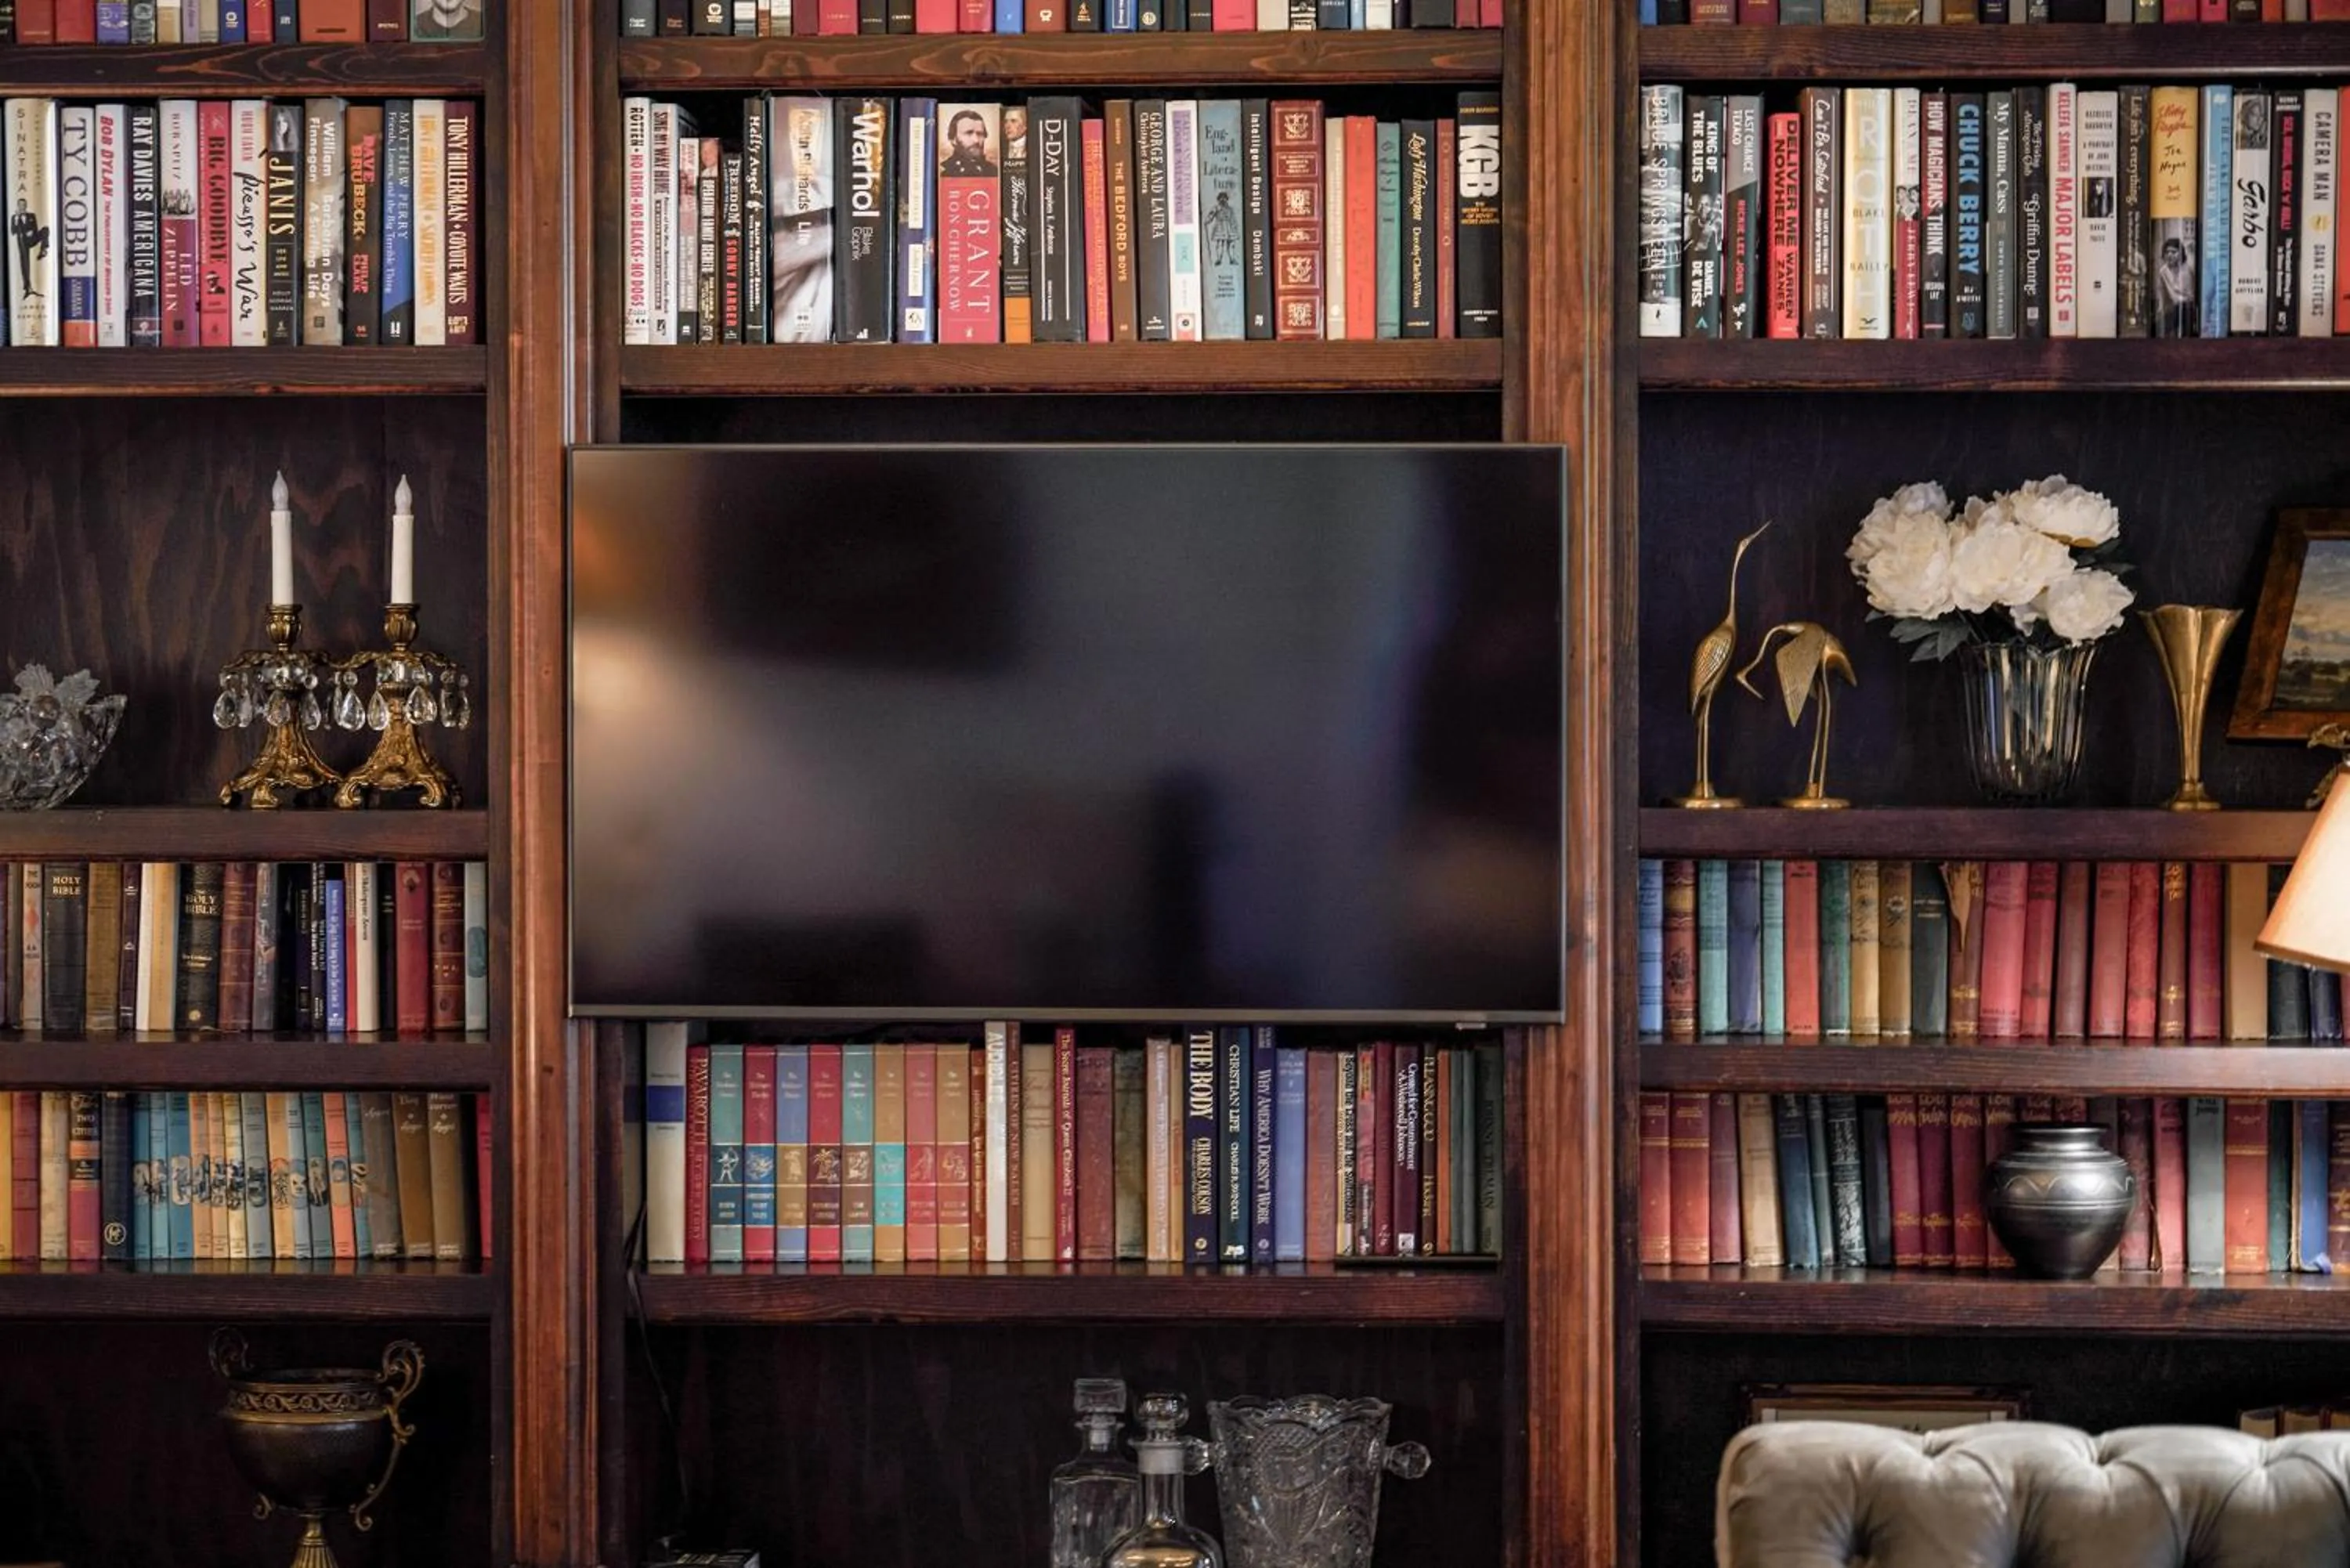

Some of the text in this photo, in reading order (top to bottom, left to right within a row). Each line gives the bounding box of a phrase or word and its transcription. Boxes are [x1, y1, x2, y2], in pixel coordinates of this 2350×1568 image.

[1137, 113, 1148, 157] Christopher
[1205, 125, 1227, 140] Eng-
[1651, 96, 1668, 150] BRUCE
[1732, 110, 1742, 145] TEXACO
[1815, 99, 1831, 132] Can't
[2057, 92, 2070, 128] KELEFA
[2130, 96, 2142, 117] Life
[2131, 119, 2141, 143] isn't
[208, 136, 226, 168] BIG
[306, 117, 320, 182] Finnegan
[322, 122, 335, 176] William
[363, 135, 374, 184] DAVE
[746, 116, 763, 194] Hell's Angel
[851, 113, 880, 217] Warhol
[1045, 119, 1061, 176] D-DAY
[1249, 114, 1261, 214] Intelligent Design
[1459, 125, 1499, 197] KGB
[1691, 110, 1704, 182] THE BLUES
[1707, 121, 1718, 173] KING OF
[1743, 110, 1754, 172] LAST CHANCE
[1994, 102, 2008, 214] My Mama, Cass
[2313, 112, 2331, 201] CAMERA MAN
[63, 117, 87, 266] TY COBB
[133, 117, 154, 298] RAY DAVIES AMERICANA
[268, 157, 295, 234] JANIS
[387, 200, 396, 214] the
[397, 113, 409, 240] MATTHEW PERRY
[631, 107, 644, 307] ROTTEN NO IRISH NO BLACKS NO DOGS
[727, 160, 740, 225] FREEDOM
[1149, 113, 1164, 238] GEORGE AND LAURA
[1408, 133, 1427, 221] Lady Washington
[1774, 137, 1787, 247] NOWHERE
[1788, 119, 1801, 247] DELIVER ME
[1927, 102, 1944, 255] HOW MAGICIANS THINK
[1958, 104, 1979, 275] CHUCK BERRY
[2055, 178, 2073, 237] MAJOR
[2126, 146, 2139, 206] everything.
[208, 175, 226, 264] GOODBYE
[306, 216, 320, 269] Surfing
[385, 215, 395, 229] Big
[447, 117, 468, 304] TONY HILLERMAN COYOTE WAITS
[1115, 186, 1126, 251] BEDFORD
[1650, 157, 1668, 269] SPRINGSTEEN
[2237, 178, 2265, 248] Garbo
[165, 227, 176, 312] ZEPPELIN
[180, 253, 191, 285] LED
[320, 195, 334, 307] Barbarian Days
[726, 239, 737, 276] SONNY
[948, 190, 960, 313] RON CHERNOW
[967, 190, 990, 313] GRANT
[1117, 255, 1126, 282] BOYS
[1253, 229, 1263, 276] Dembski
[1704, 261, 1714, 298] DANIEL
[1735, 200, 1745, 294] RICKIE LEE JONES
[2024, 249, 2040, 295] Dunne
[2055, 243, 2073, 303] LABELS
[236, 262, 258, 321] War
[308, 274, 320, 298] Life
[1776, 259, 1786, 313] ZANES
[1786, 252, 1797, 321] WARREN
[2312, 244, 2326, 317] DANA STEVENS
[52, 876, 81, 886] HOLY
[1061, 1035, 1070, 1048] The
[693, 1057, 708, 1145] PAVAROTTI
[1190, 1031, 1213, 1120] THE BODY
[1228, 1044, 1240, 1133] CHRISTIAN LIFE
[1256, 1069, 1271, 1096] WHY
[1063, 1110, 1072, 1118] of
[1257, 1097, 1271, 1143] AMERICA
[1196, 1137, 1212, 1215] CHARLES COLSON
[1256, 1193, 1271, 1224] WORK
